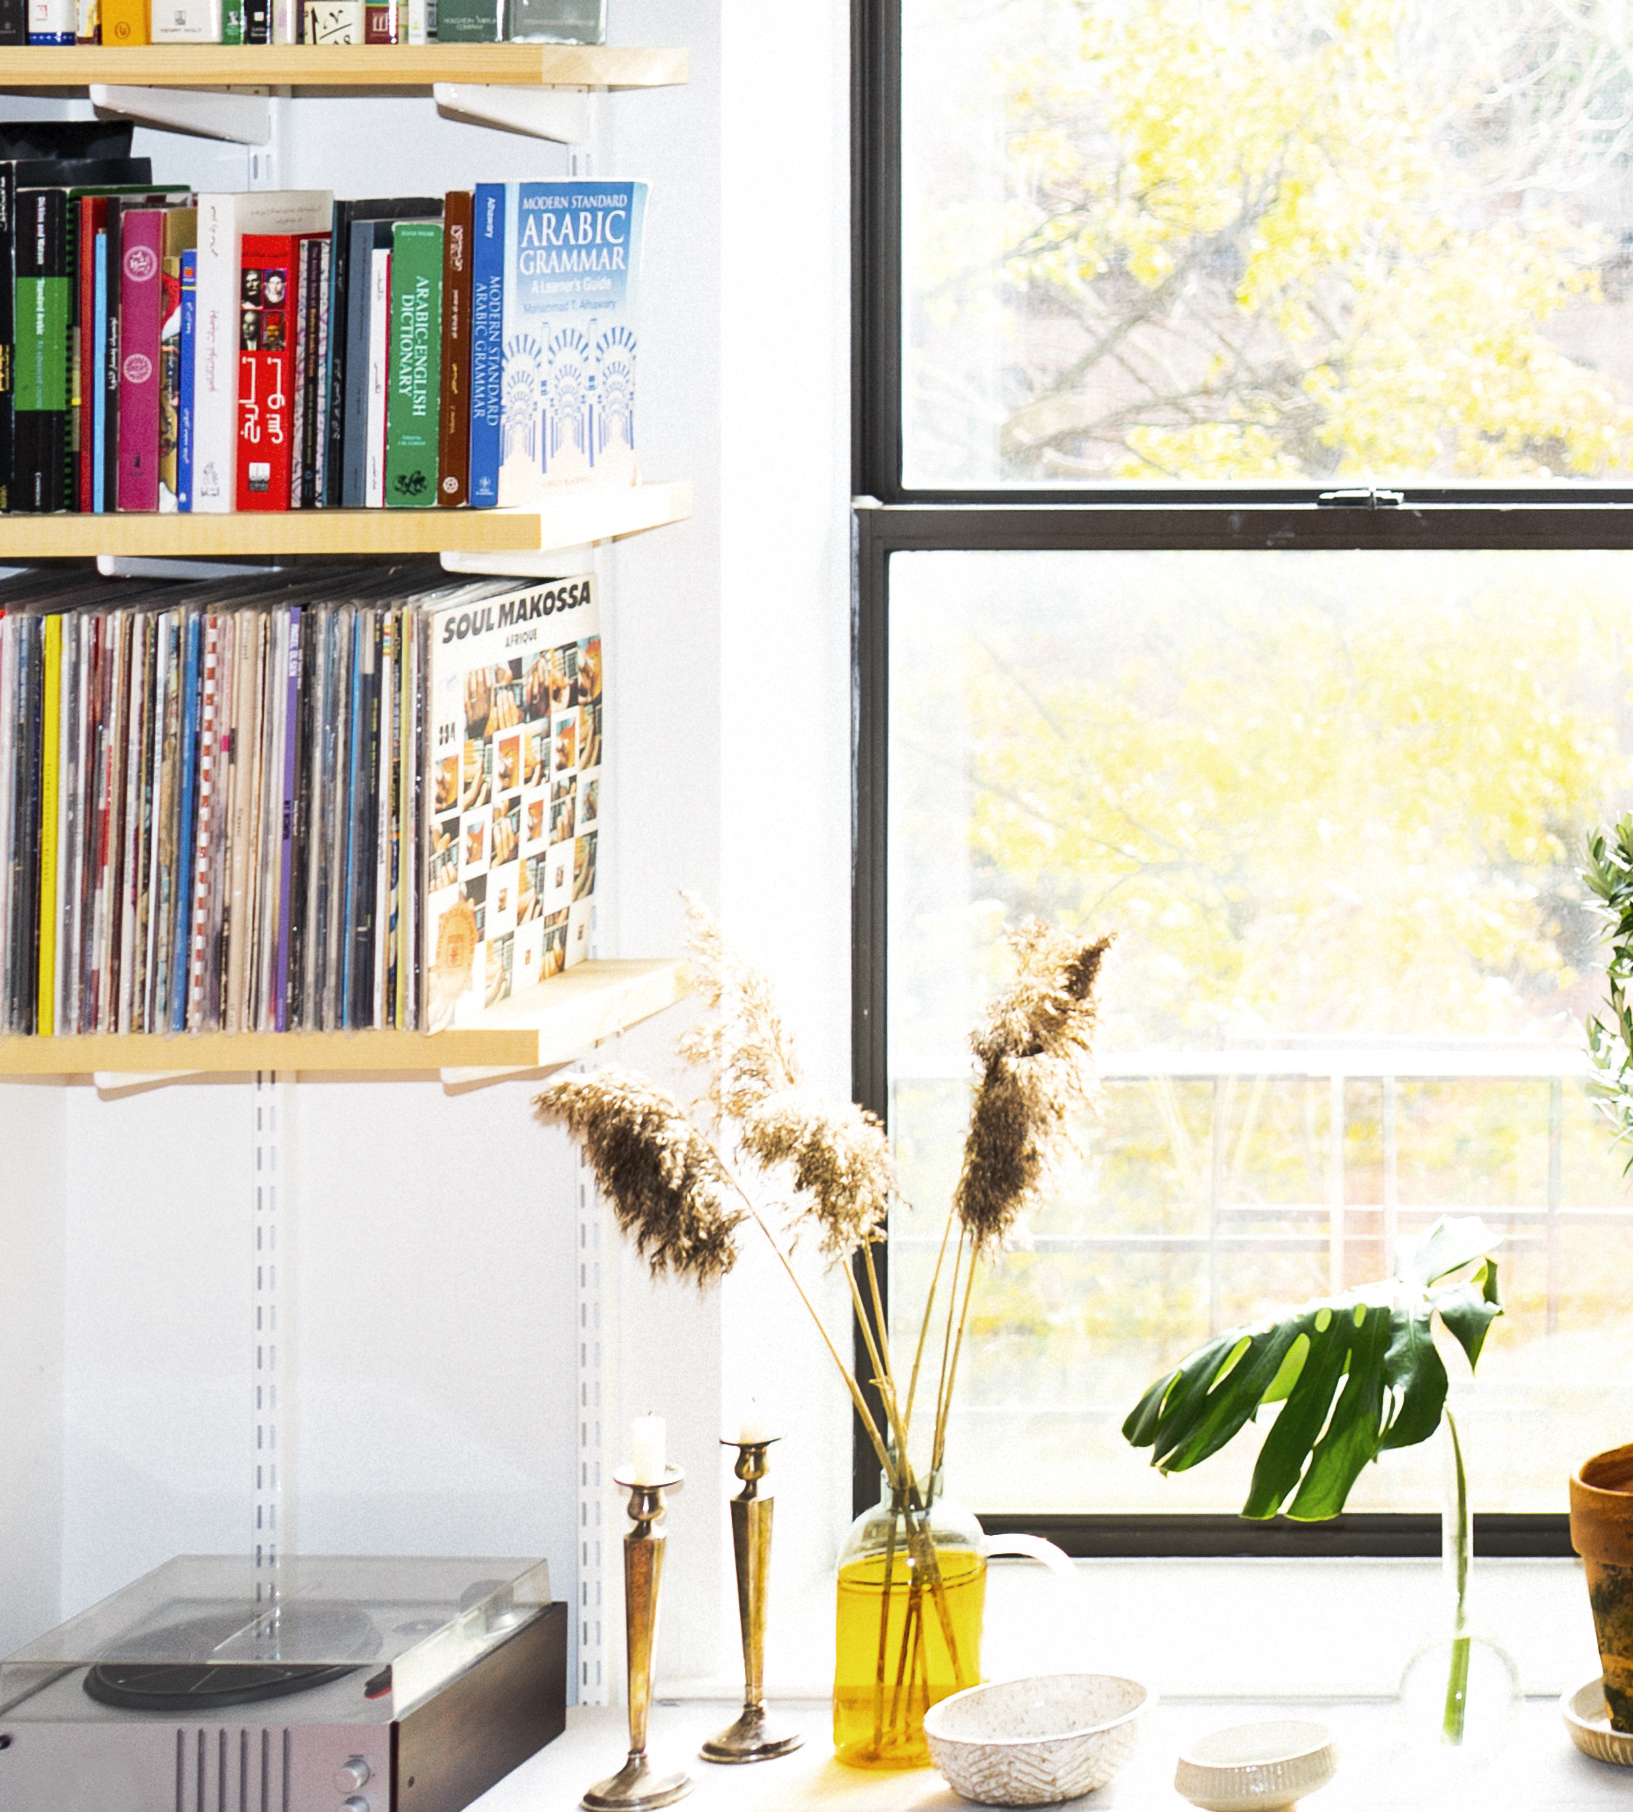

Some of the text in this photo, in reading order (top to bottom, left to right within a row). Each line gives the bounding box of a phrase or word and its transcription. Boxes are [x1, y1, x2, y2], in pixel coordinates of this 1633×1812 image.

[524, 194, 627, 210] MODERN STANDARD
[522, 211, 625, 247] ARABIC
[520, 247, 626, 275] GRAMMAR
[401, 295, 412, 396] DICTIONARY
[414, 276, 428, 416] ARABIC-ENGLISH
[444, 583, 591, 643] SOUL MAKOSSA
[505, 628, 538, 648] AFRIQUE
